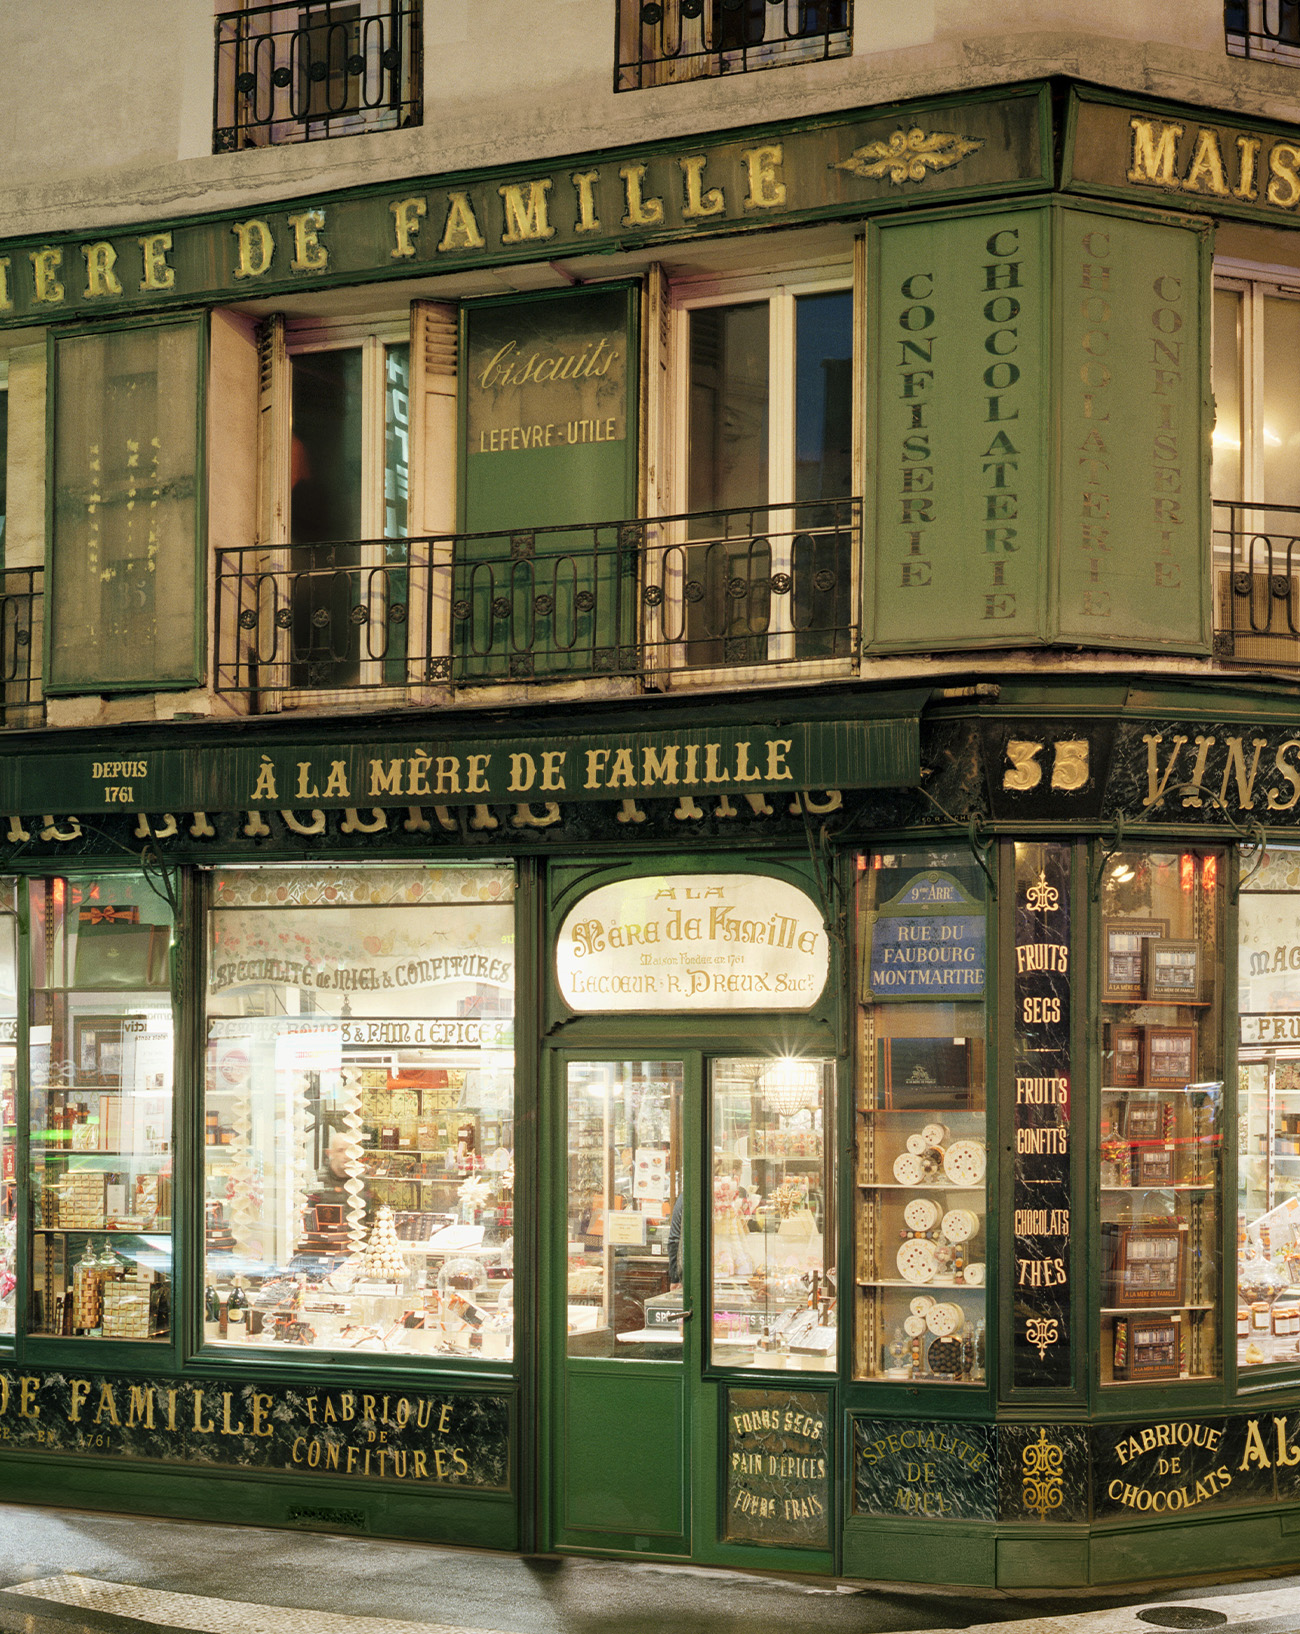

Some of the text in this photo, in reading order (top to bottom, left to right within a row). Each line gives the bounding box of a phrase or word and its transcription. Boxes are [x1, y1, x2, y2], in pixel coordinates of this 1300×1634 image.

[1127, 116, 1300, 207] MAIS
[233, 212, 328, 280] DE
[390, 143, 787, 258] FAMILLE
[478, 338, 619, 391] biscuits
[897, 273, 937, 588] CONFISERIE
[980, 230, 1024, 620] CHOCOLATERIE
[1079, 231, 1113, 617] CHOCOLATERIE
[1148, 275, 1184, 589] CONFISERIE
[92, 761, 148, 778] DEPUIS
[251, 739, 793, 799] À LA MÈRE DE FAMILLE
[1003, 739, 1090, 790] 35
[1143, 733, 1300, 811] VINS
[104, 787, 135, 802] 1761
[686, 886, 725, 899] LA
[898, 924, 964, 941] RUE DU
[640, 952, 678, 965] Maison
[727, 954, 745, 967] 1761
[883, 946, 976, 964] FAUBOURG
[1015, 943, 1069, 973] FRUITS
[332, 968, 380, 991] MIEL
[382, 969, 394, 986] &
[395, 953, 513, 987] CONFITURES
[872, 968, 985, 986] MONTMARTRE
[1023, 997, 1061, 1024] SECS
[354, 1026, 365, 1043] &
[367, 1022, 411, 1044] PAIN
[1016, 1077, 1068, 1104] FRUITS
[1016, 1127, 1067, 1155] CONFITS
[1014, 1209, 1069, 1237] CHOCOLATS
[1018, 1258, 1067, 1287] THÉS
[67, 1379, 274, 1437] FAMILLE
[305, 1393, 454, 1434] FABRIQUE
[367, 1429, 388, 1443] DE
[733, 1410, 823, 1440] FOURS SECS
[292, 1436, 469, 1479] CONFITURES
[862, 1429, 990, 1473] SPECIALITÉ
[1114, 1422, 1222, 1465] FABRIQUE
[732, 1452, 762, 1475] PAIN
[907, 1462, 937, 1483] DE
[1158, 1456, 1182, 1476] DE
[893, 1488, 952, 1513] MIEL
[1107, 1464, 1233, 1513] CHOCOLATS
[785, 1494, 823, 1520] FRAIS
